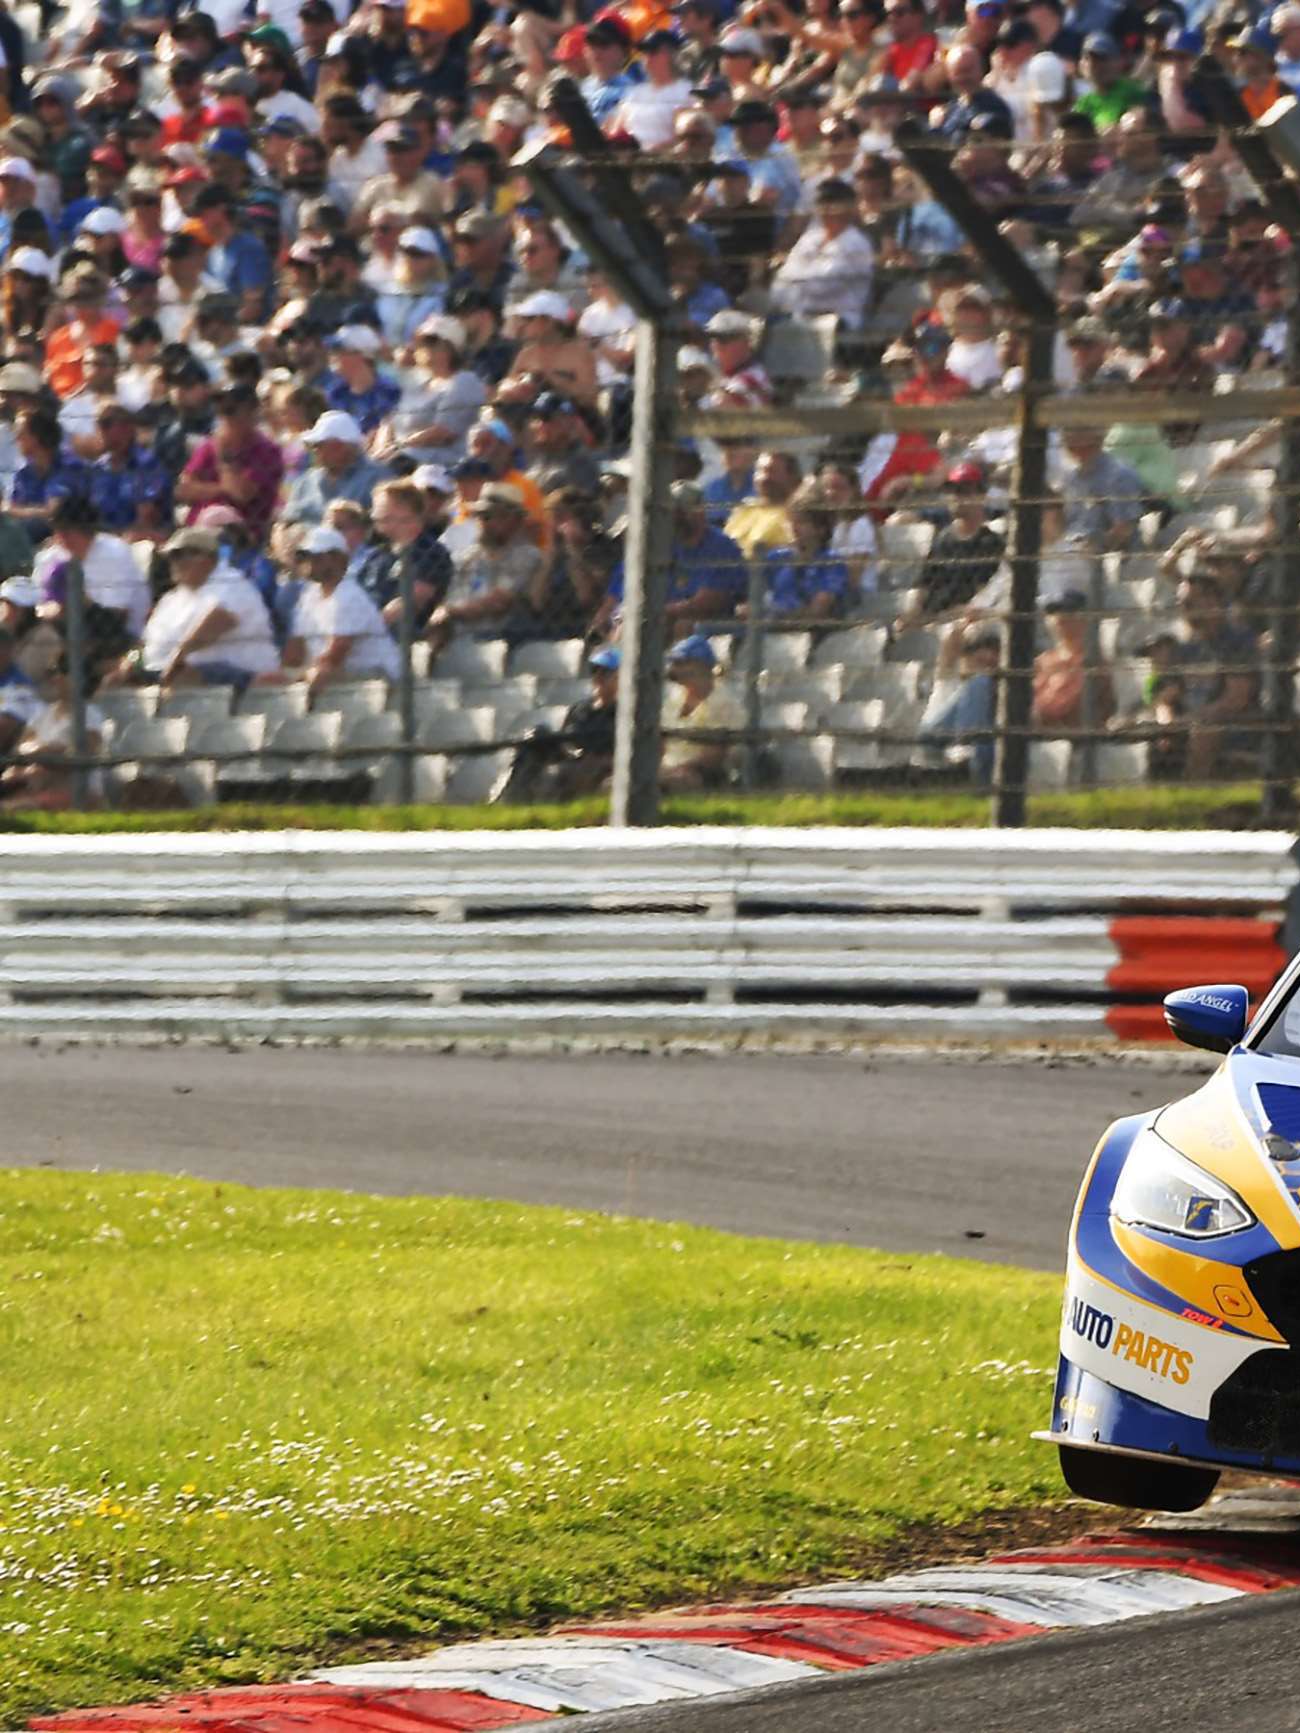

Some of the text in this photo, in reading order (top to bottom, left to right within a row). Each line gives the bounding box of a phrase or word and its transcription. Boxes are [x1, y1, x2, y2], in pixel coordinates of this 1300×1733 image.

[1068, 1297, 1194, 1385] AUTO PARTS
[1182, 1308, 1214, 1325] TOW
